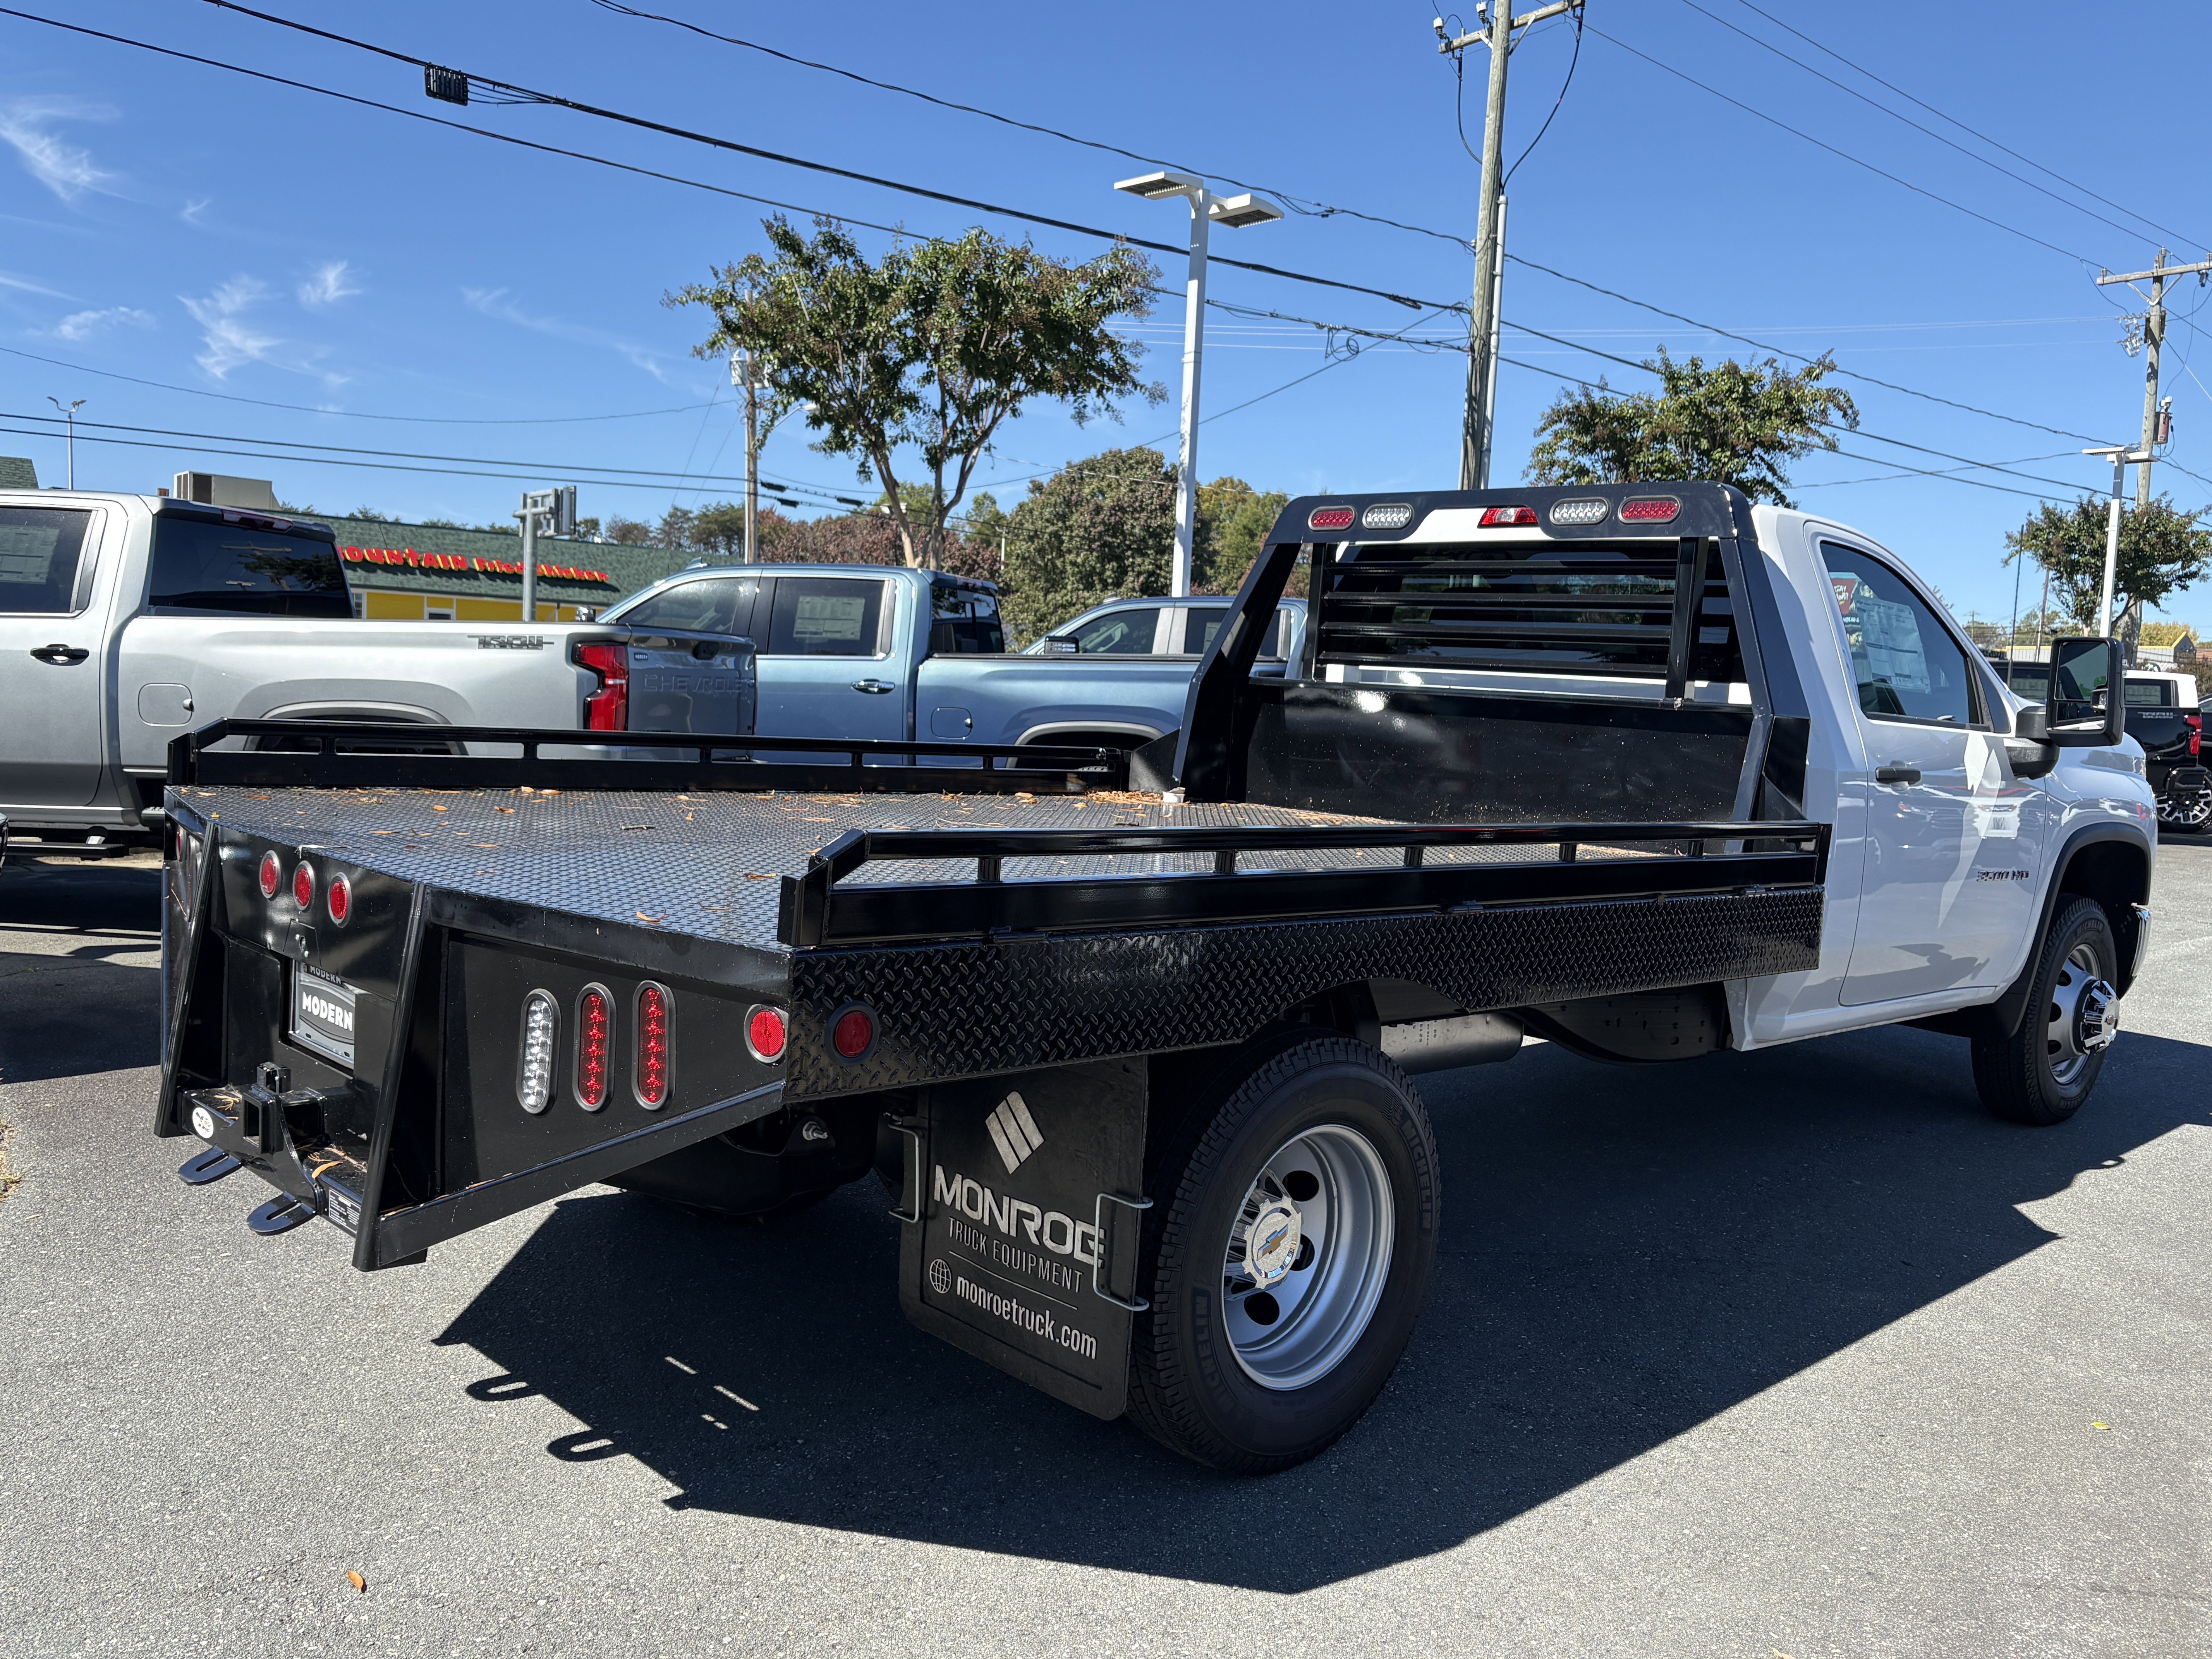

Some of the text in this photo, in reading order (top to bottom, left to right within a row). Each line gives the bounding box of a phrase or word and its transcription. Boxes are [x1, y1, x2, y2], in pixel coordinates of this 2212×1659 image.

[643, 674, 755, 692] CHEVROLET
[2011, 871, 2029, 880] HD
[310, 965, 341, 985] MODERN
[302, 991, 353, 1032] MODERN
[1401, 1119, 1432, 1230] MICHELIN
[934, 1164, 1106, 1269] MONROE
[948, 1217, 1084, 1293] TRUCK EQUIPMENT
[957, 1275, 1098, 1360] monroetruck.com
